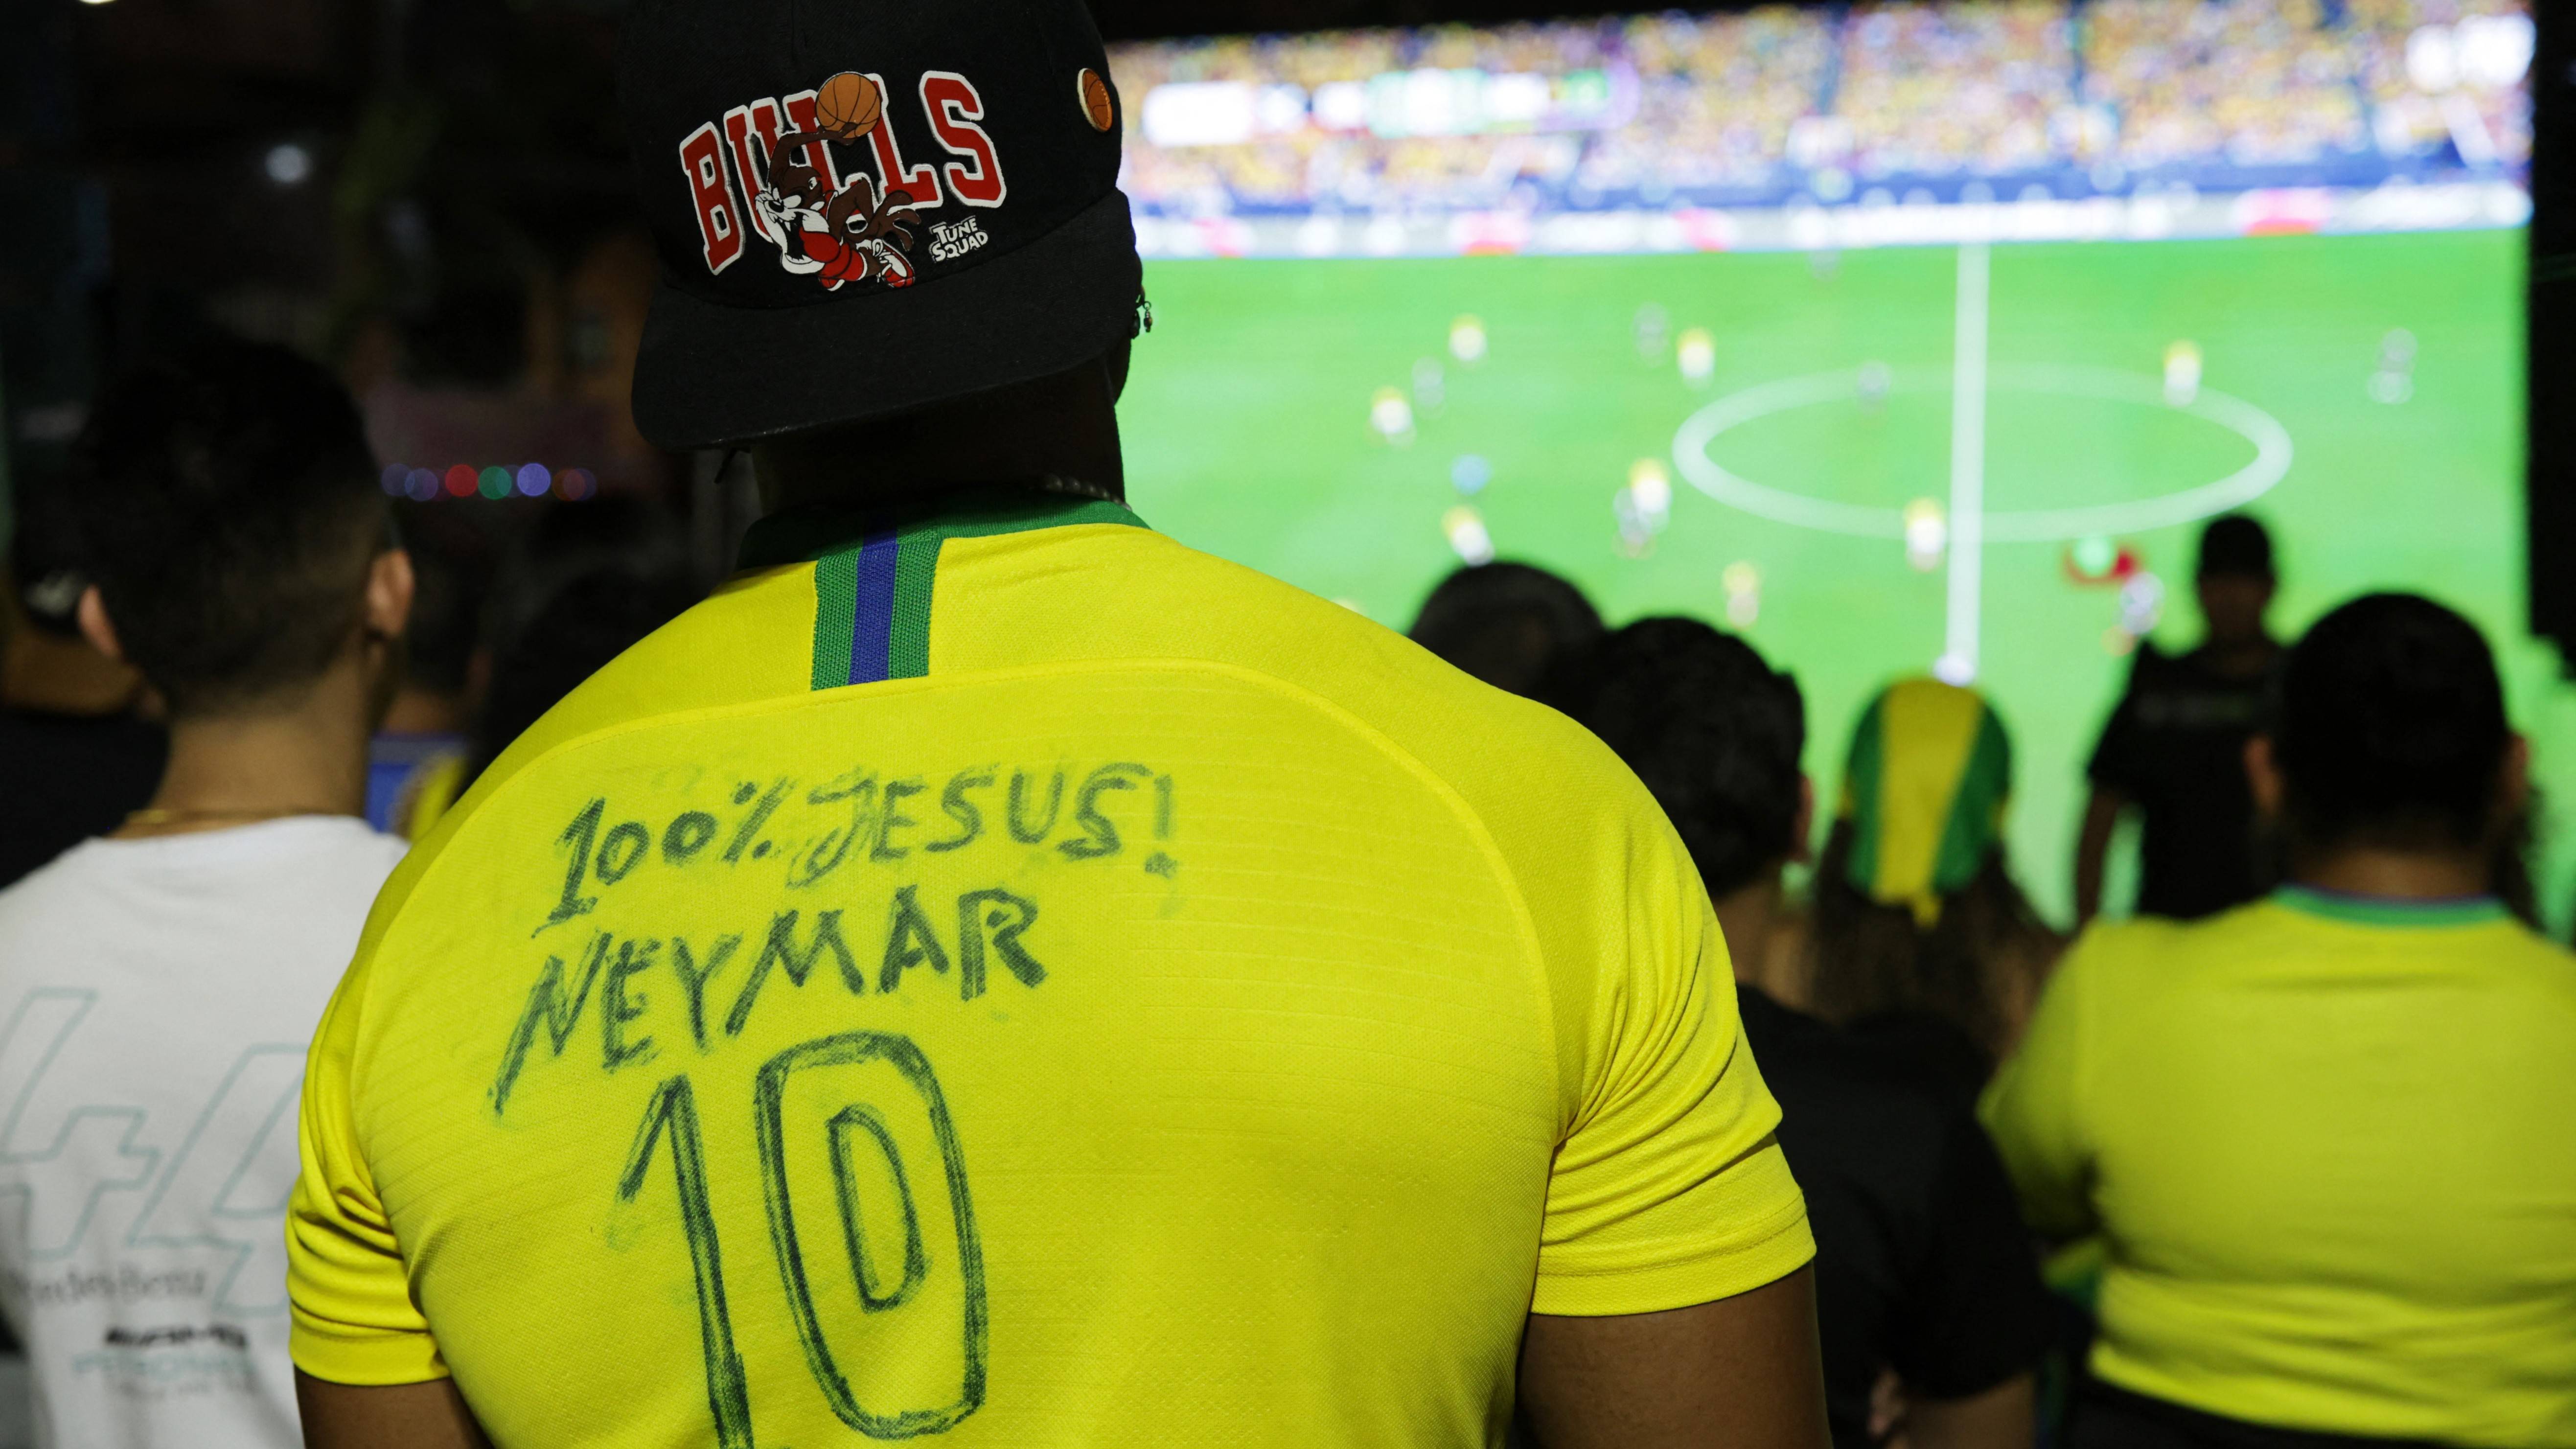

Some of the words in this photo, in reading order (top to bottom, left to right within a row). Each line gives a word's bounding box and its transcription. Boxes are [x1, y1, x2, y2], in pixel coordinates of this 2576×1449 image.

[680, 70, 1007, 276] BULLS
[931, 231, 989, 262] SQUAD
[932, 217, 978, 245] TUNE
[531, 773, 793, 939] 100%
[785, 761, 1177, 888] JESUS!
[487, 885, 1047, 1118] NEYMAR
[612, 1029, 989, 1449] 10
